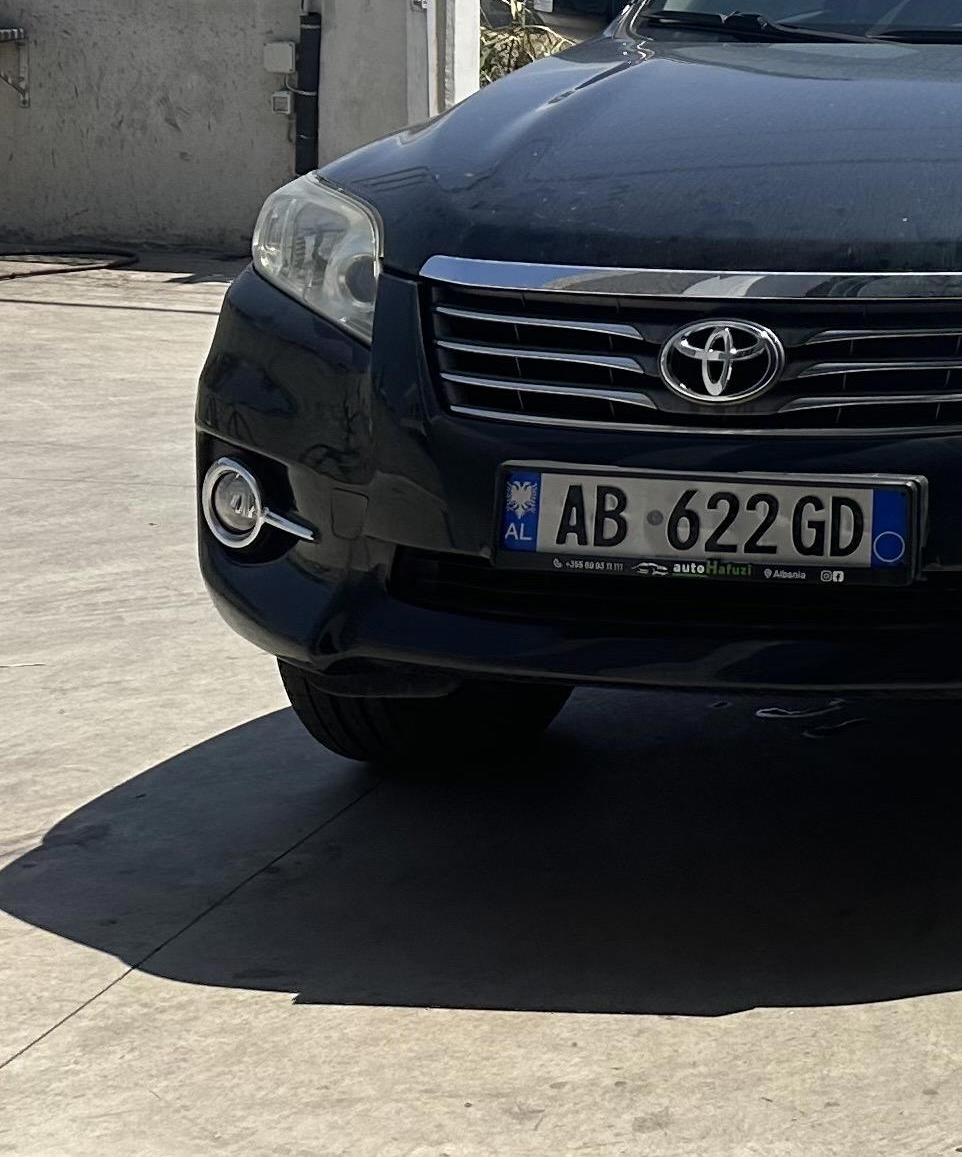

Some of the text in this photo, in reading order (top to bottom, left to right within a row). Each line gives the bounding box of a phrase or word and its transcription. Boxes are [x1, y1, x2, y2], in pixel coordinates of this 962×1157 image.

[555, 484, 628, 547] AB
[504, 522, 533, 541] AL
[773, 569, 806, 579] Albania
